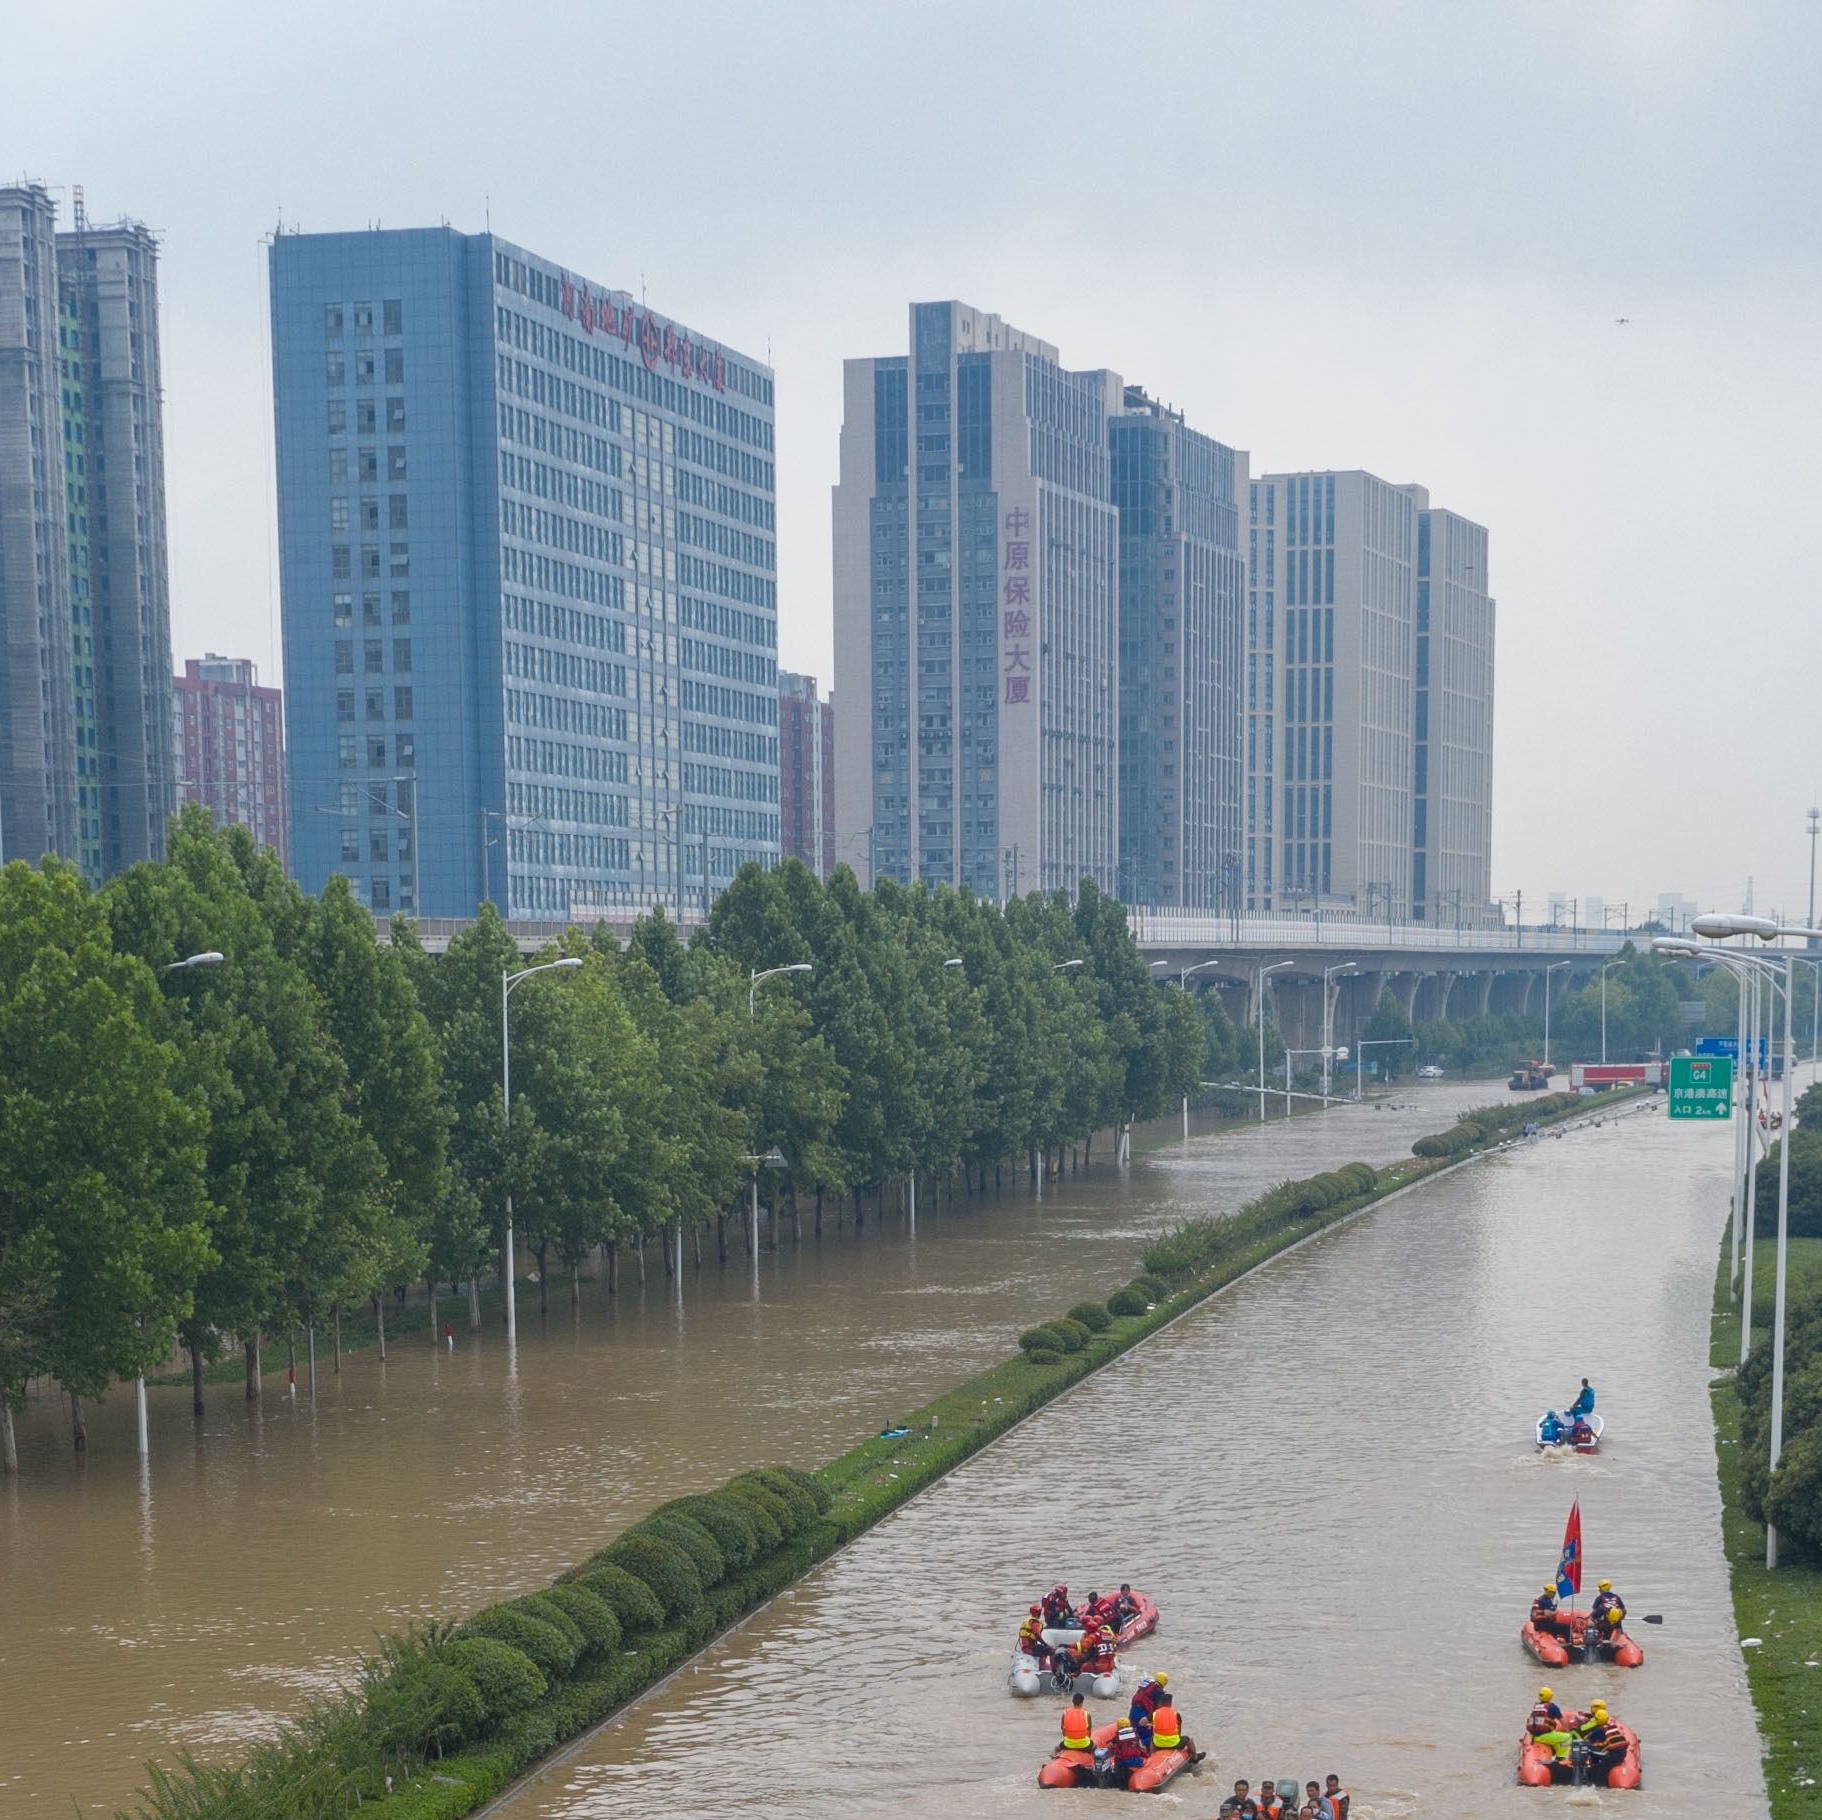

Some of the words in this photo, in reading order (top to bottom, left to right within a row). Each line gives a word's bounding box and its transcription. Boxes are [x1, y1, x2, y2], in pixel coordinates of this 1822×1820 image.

[1004, 506, 1031, 705] 中原保险大厦
[1692, 1070, 1707, 1081] G4
[1673, 1087, 1728, 1099] 京港澳高速
[1673, 1105, 1692, 1115] 入口
